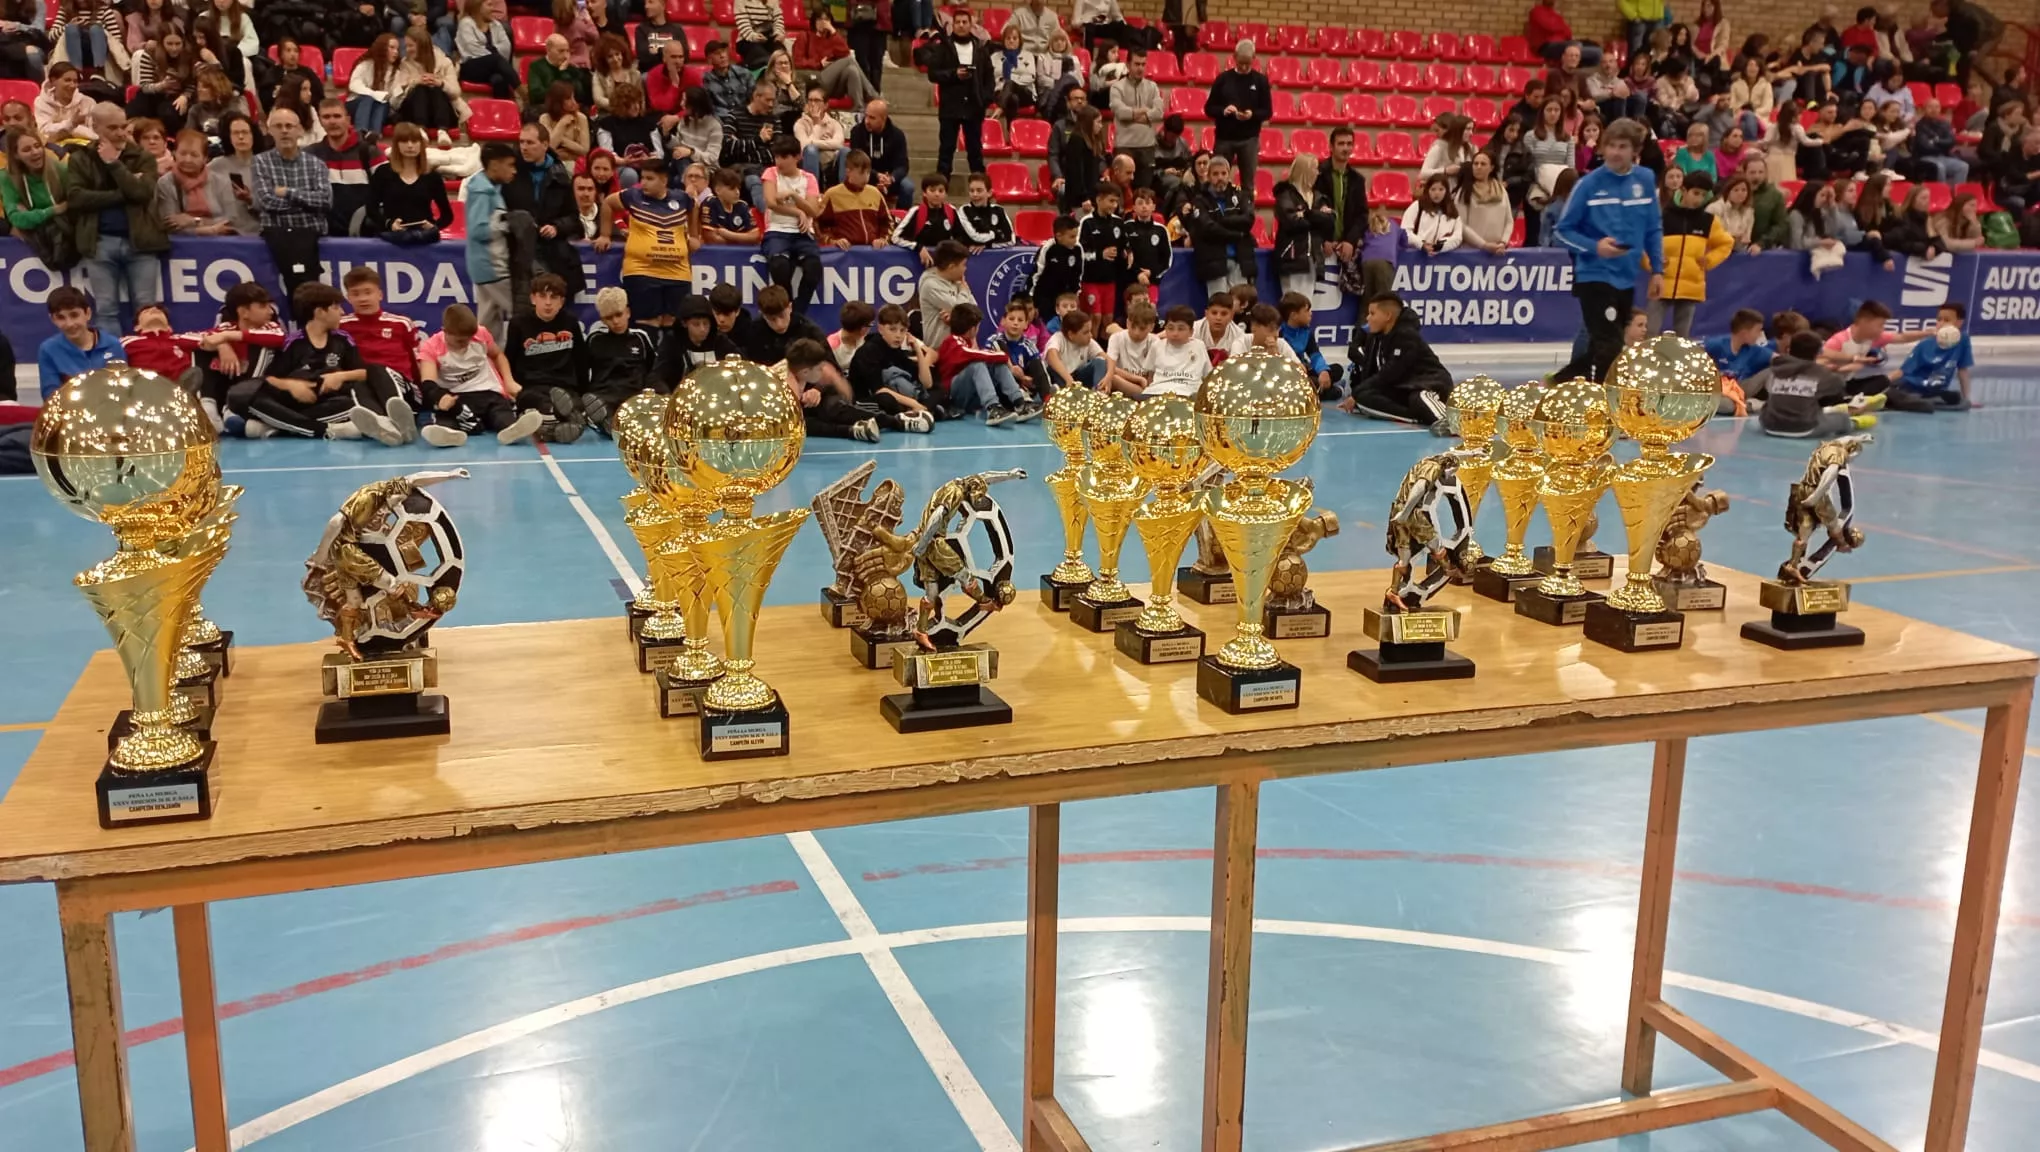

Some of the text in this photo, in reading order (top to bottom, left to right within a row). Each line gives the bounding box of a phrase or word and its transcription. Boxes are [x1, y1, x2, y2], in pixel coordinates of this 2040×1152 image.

[1391, 258, 1573, 293] AUTOMÓVILE
[1401, 299, 1535, 326] ERRABLO
[1981, 297, 2040, 321] SERR
